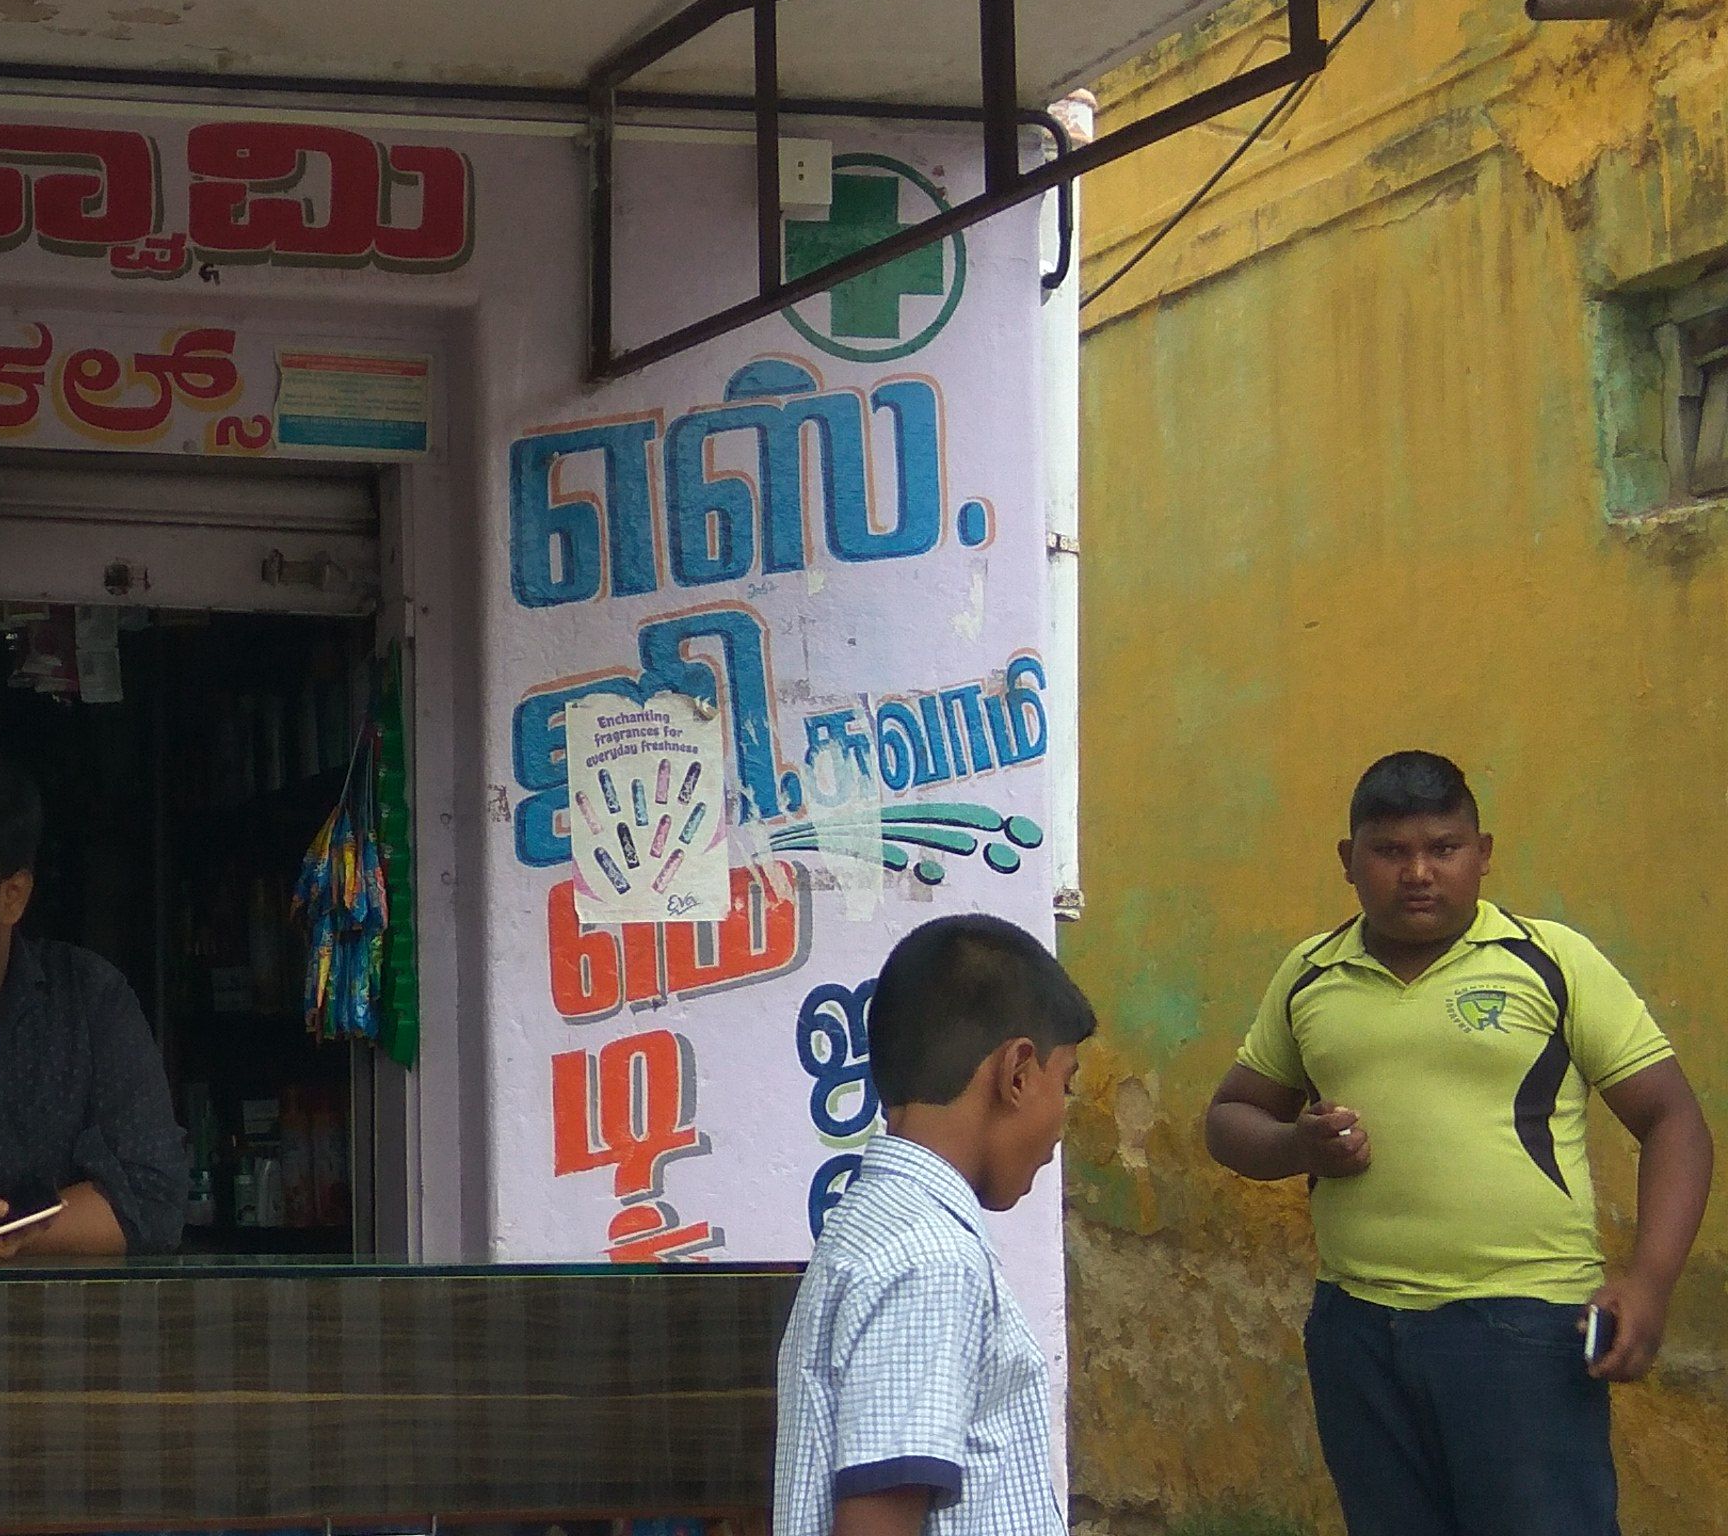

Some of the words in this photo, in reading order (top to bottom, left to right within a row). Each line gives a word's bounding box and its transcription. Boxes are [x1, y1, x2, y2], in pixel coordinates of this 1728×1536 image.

[597, 709, 670, 729] Enchanting
[594, 728, 660, 747] fragrances
[663, 726, 683, 739] for
[586, 743, 638, 768] everyday
